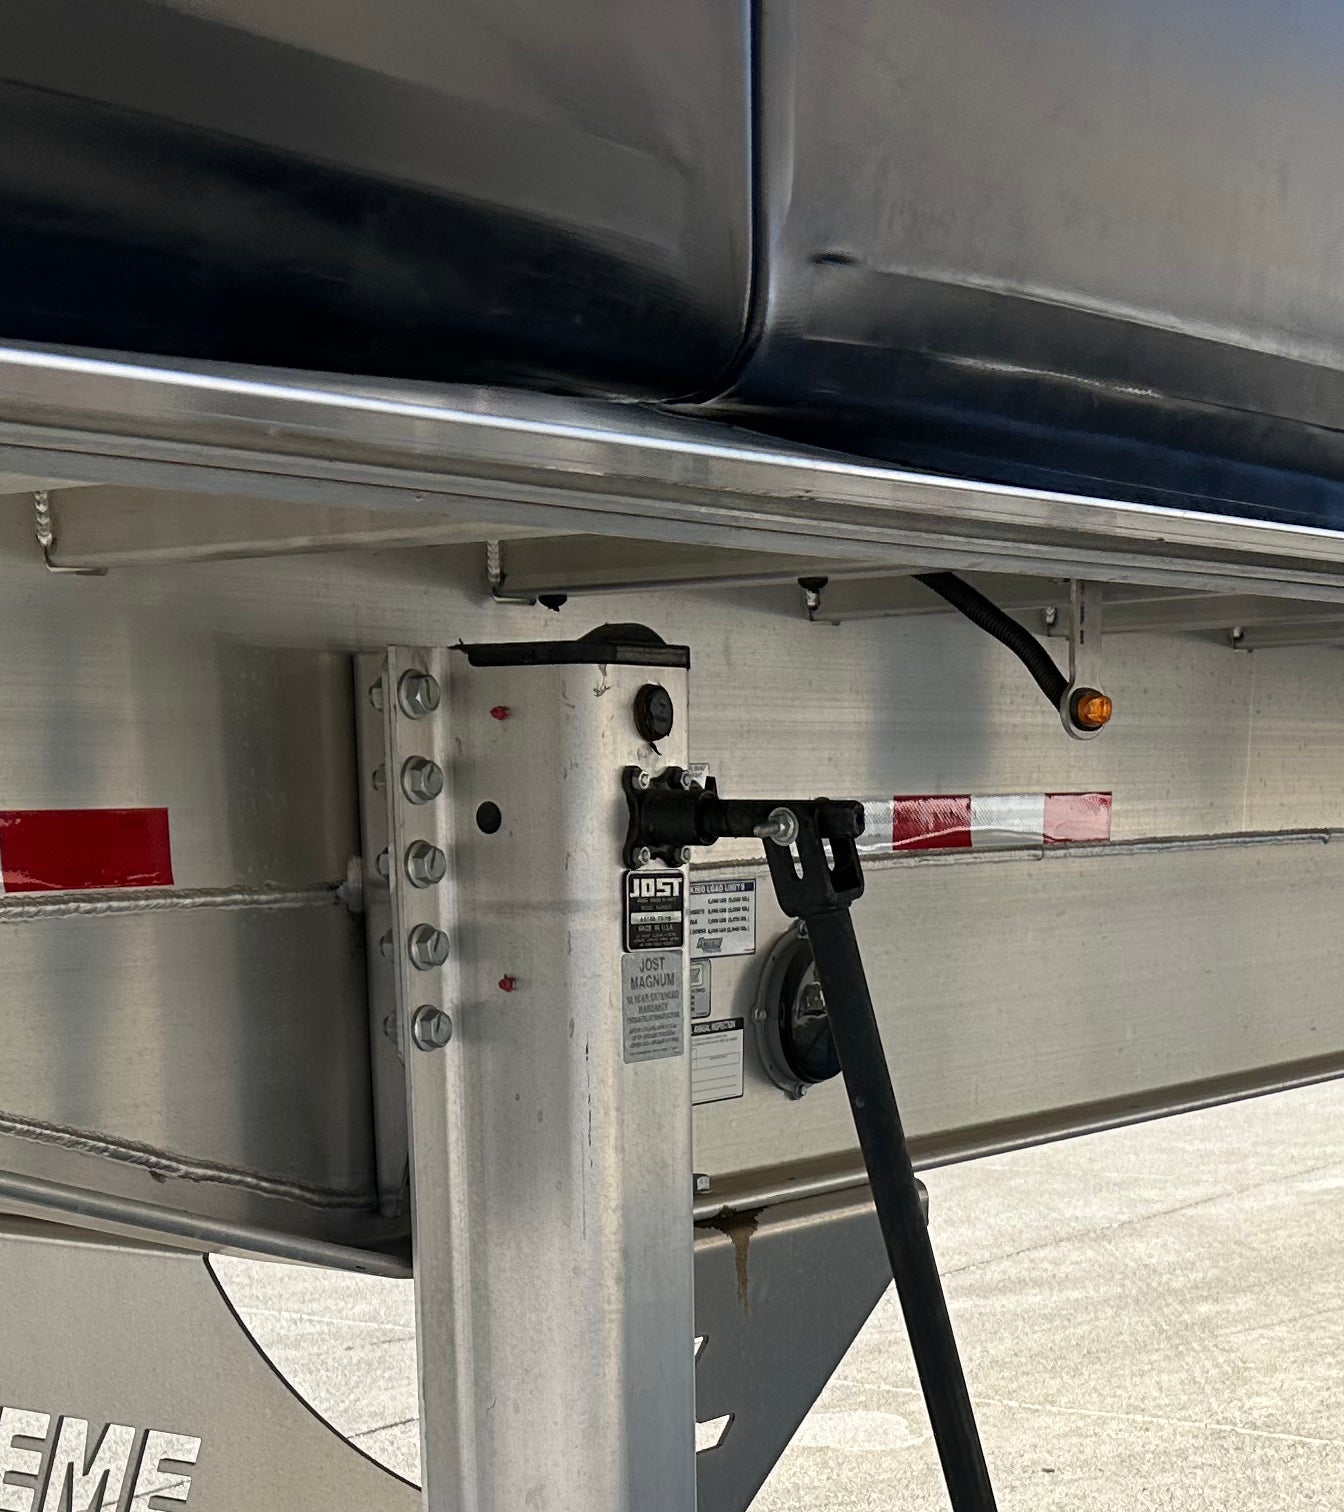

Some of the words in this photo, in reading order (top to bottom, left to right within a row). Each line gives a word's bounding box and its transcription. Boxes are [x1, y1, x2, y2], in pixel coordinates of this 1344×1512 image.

[629, 877, 683, 898] JOST
[639, 956, 665, 973] JOST
[630, 972, 675, 990] MAGNUM
